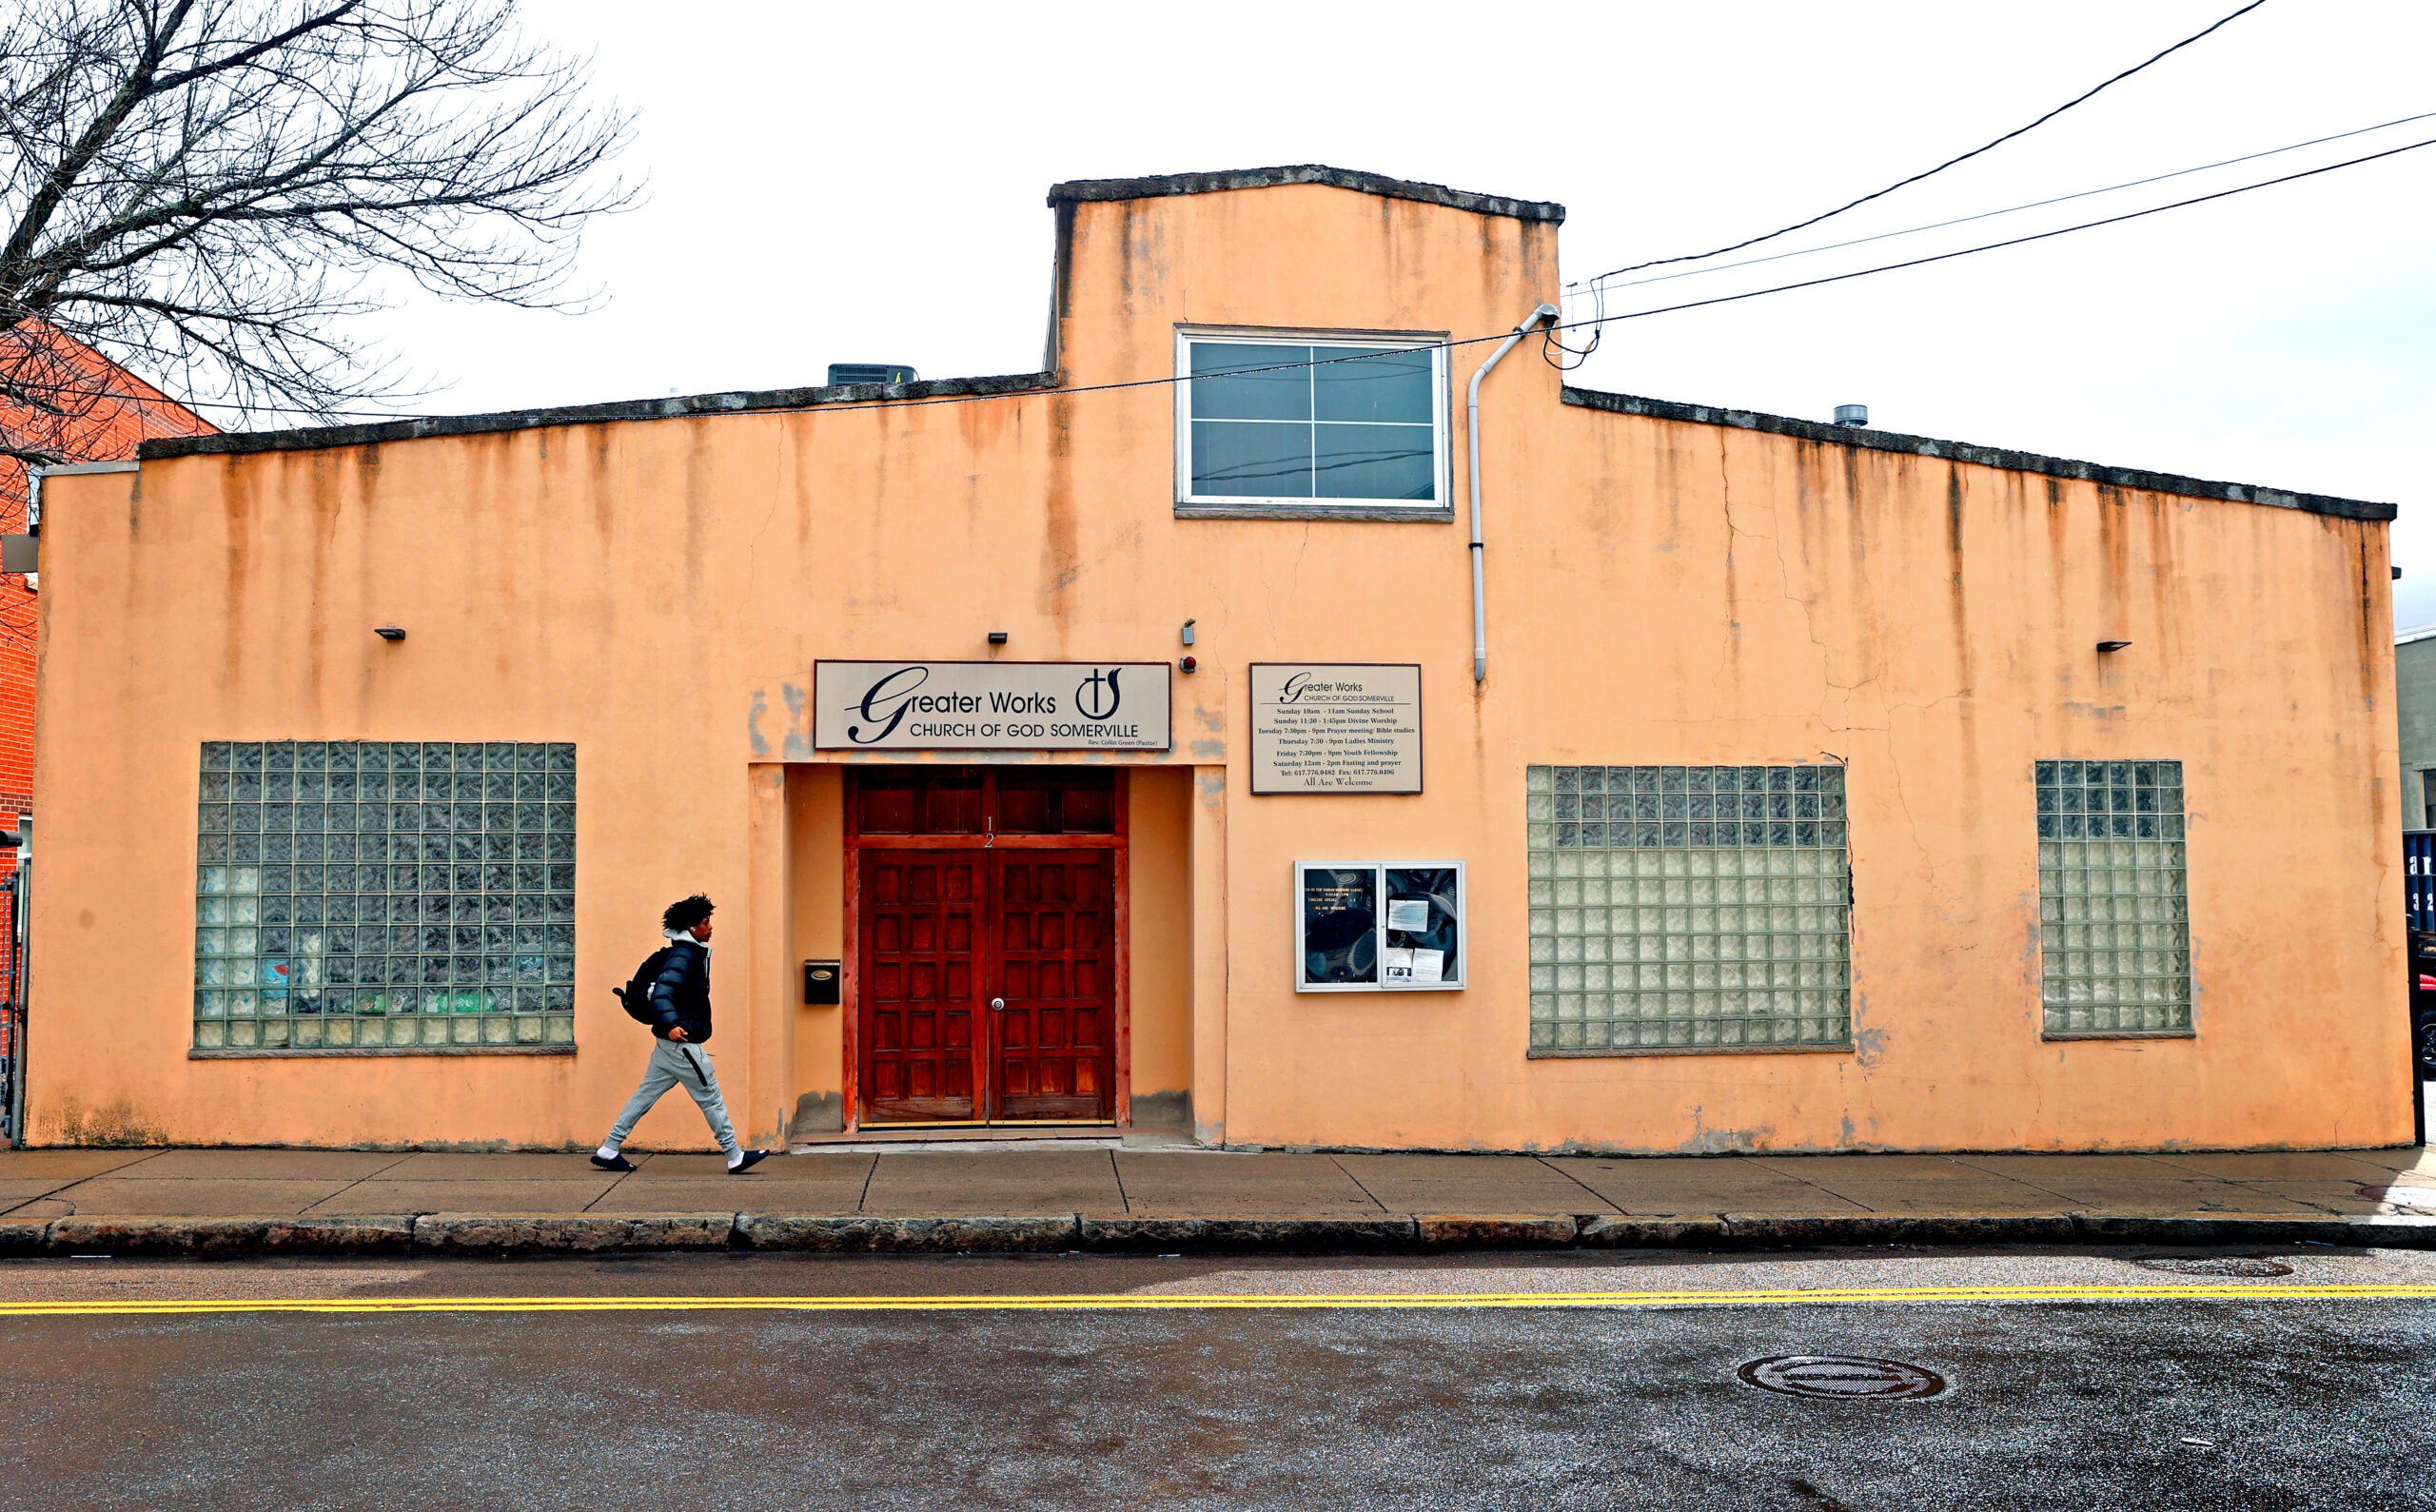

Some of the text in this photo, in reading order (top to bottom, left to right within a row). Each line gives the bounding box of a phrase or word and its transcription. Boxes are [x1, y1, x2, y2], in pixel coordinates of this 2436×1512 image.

[1278, 672, 1363, 704] Greater Works
[844, 666, 1057, 744] Greater Works
[1273, 717, 1298, 726] Sunday
[1324, 717, 1346, 726] 1:45pm
[1370, 717, 1398, 726] Worship
[909, 723, 1139, 738] CHURCH OF GOD SOMERVILLE
[1326, 727, 1347, 736] Prayer
[1278, 737, 1308, 746] Thursday
[1367, 737, 1395, 746] Ministry
[1276, 750, 1297, 758] Friday
[1364, 749, 1399, 757] Fellowship
[1272, 760, 1303, 769] Saturday
[1342, 759, 1365, 768] Fasting
[1303, 776, 1373, 787] All Are Welcome
